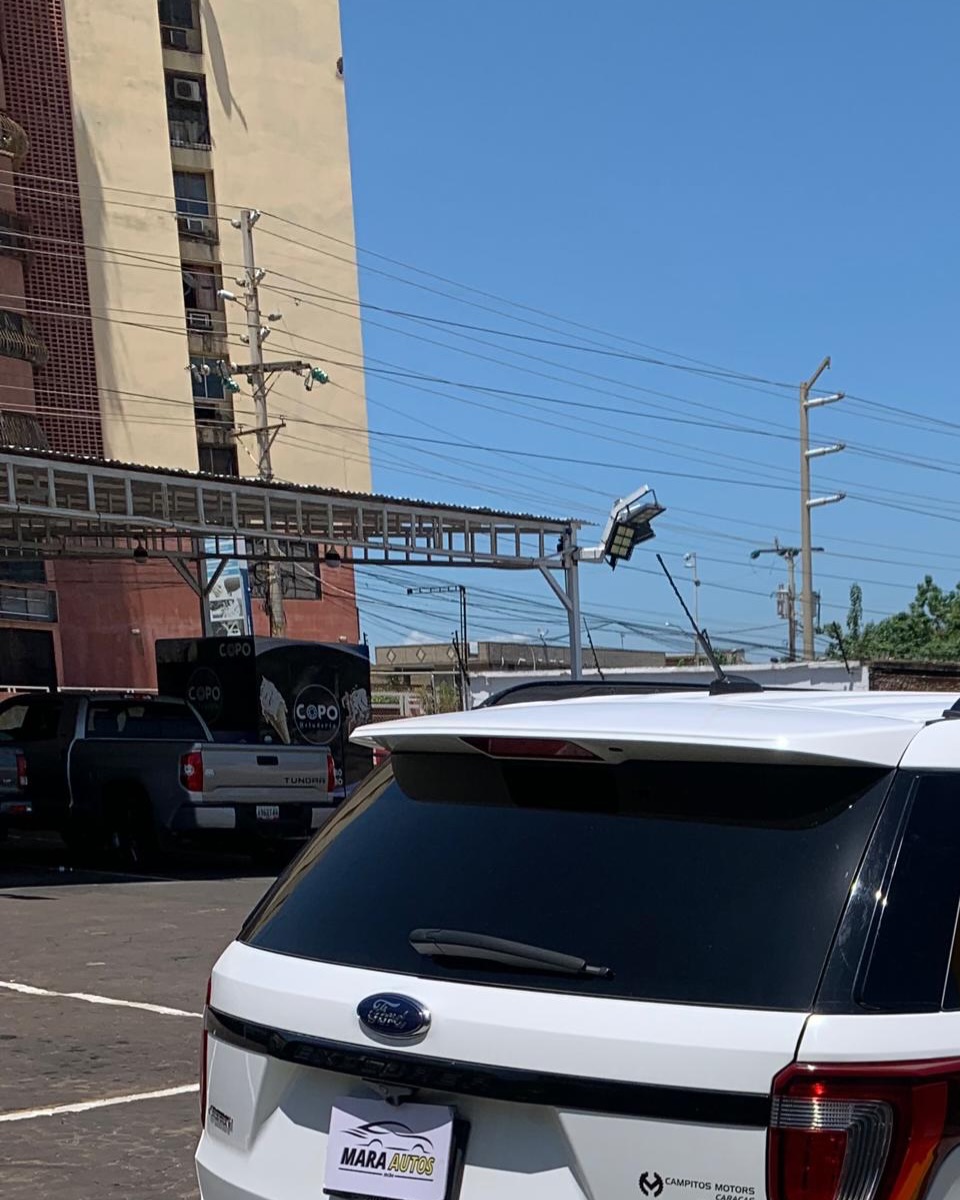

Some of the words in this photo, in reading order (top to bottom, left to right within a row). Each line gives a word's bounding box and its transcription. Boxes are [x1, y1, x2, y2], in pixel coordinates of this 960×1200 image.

[219, 642, 251, 657] COPO
[188, 686, 221, 701] COPO
[296, 703, 339, 721] COPO
[340, 1147, 387, 1170] MARA
[387, 1152, 436, 1176] AUTOS
[664, 1177, 712, 1191] CAMPITOS
[714, 1183, 755, 1195] MOTORS
